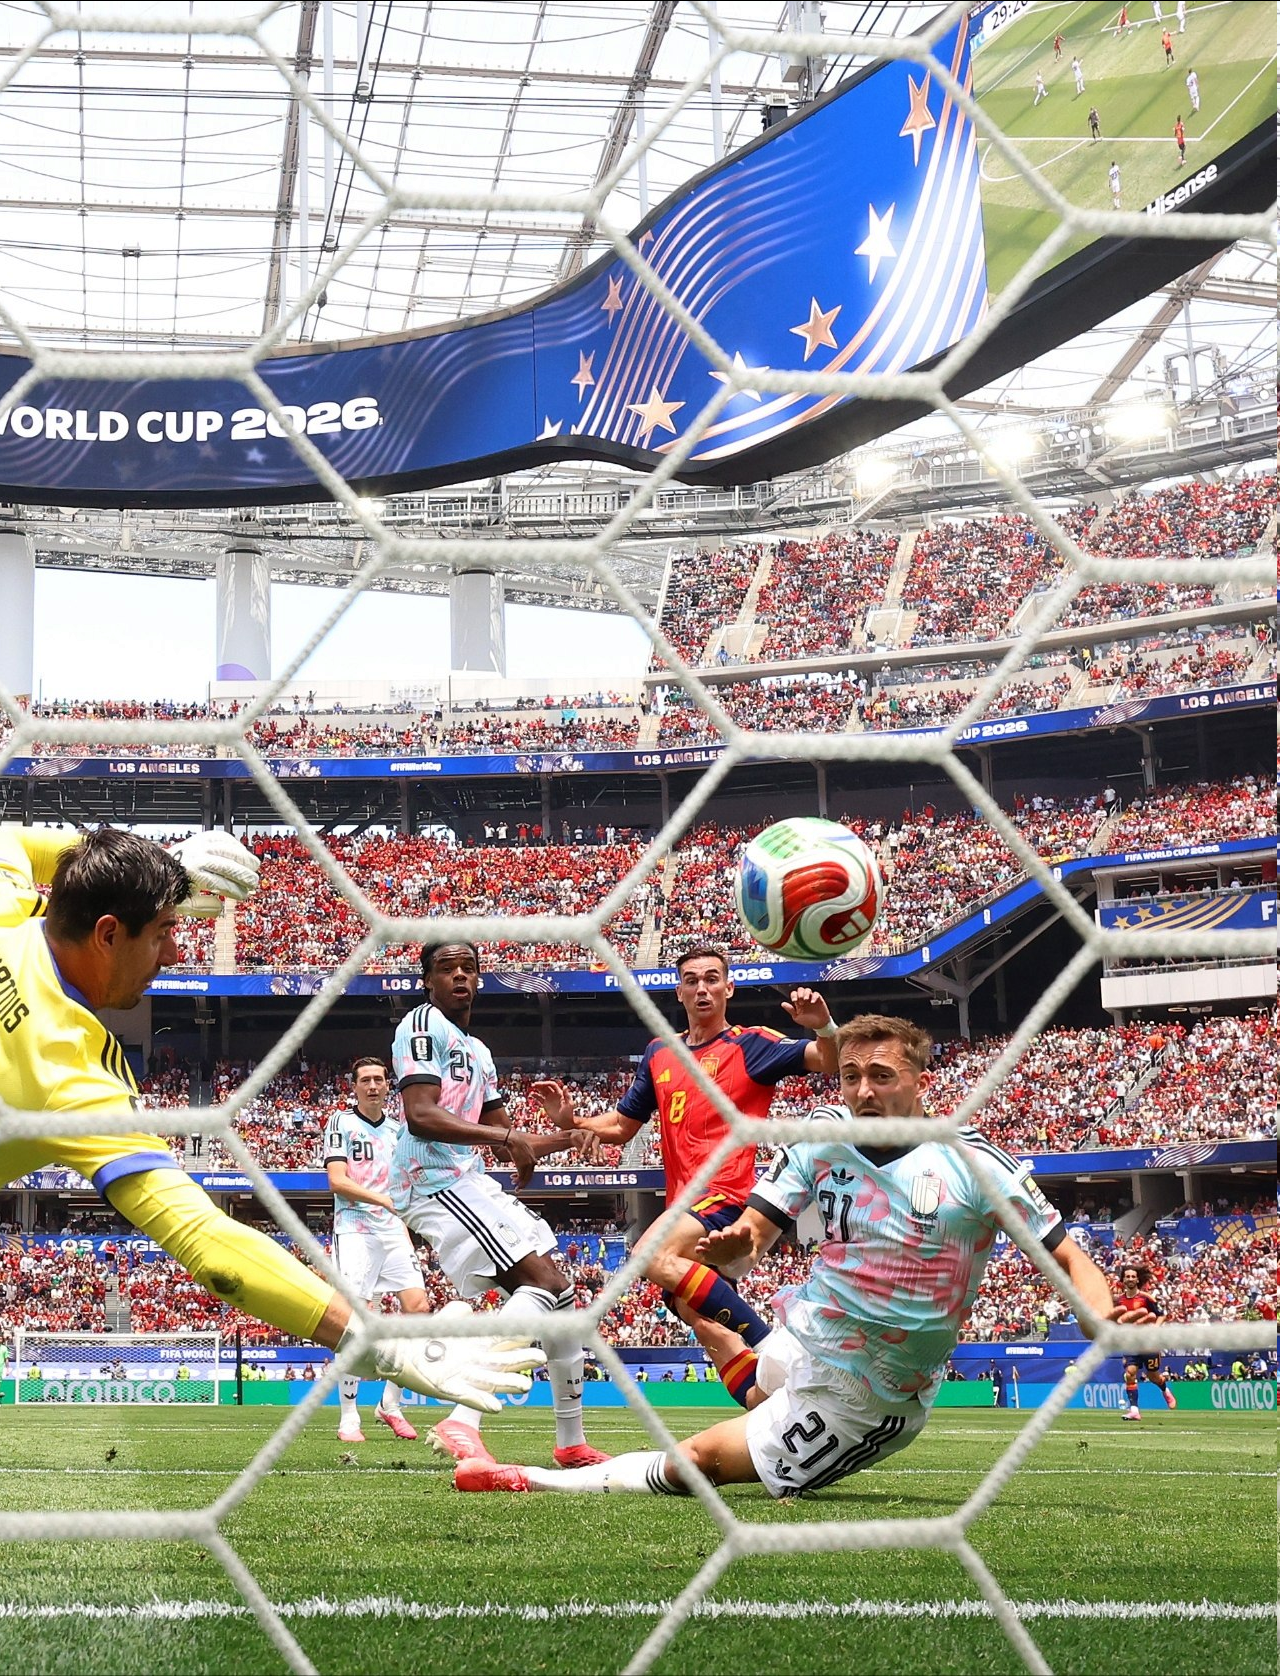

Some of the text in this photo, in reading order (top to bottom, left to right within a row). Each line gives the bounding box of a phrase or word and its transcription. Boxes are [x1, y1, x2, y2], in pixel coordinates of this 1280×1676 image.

[1146, 164, 1218, 217] Hisense
[136, 410, 223, 443] CUP
[229, 397, 380, 441] 2026
[1180, 695, 1209, 710] LOS
[982, 720, 1028, 738] 2026
[634, 750, 726, 766] LOS ANGELES
[109, 762, 200, 774] LOS ANGELES
[1125, 845, 1220, 862] FIFA WORLD CUP 2026
[151, 980, 208, 992] #FIFAWorldCup
[382, 979, 411, 991] LOS
[637, 972, 681, 986] WORL
[449, 1050, 474, 1086] 25
[670, 1091, 686, 1124] 8
[352, 1140, 374, 1162] 20
[544, 1173, 638, 1186] LOS ANGELES
[818, 1190, 853, 1242] 21
[241, 1349, 277, 1359] 2026
[43, 1381, 176, 1402] aramco
[1083, 1382, 1127, 1410] aram
[1211, 1381, 1275, 1410] aramco
[781, 1410, 839, 1471] 21
